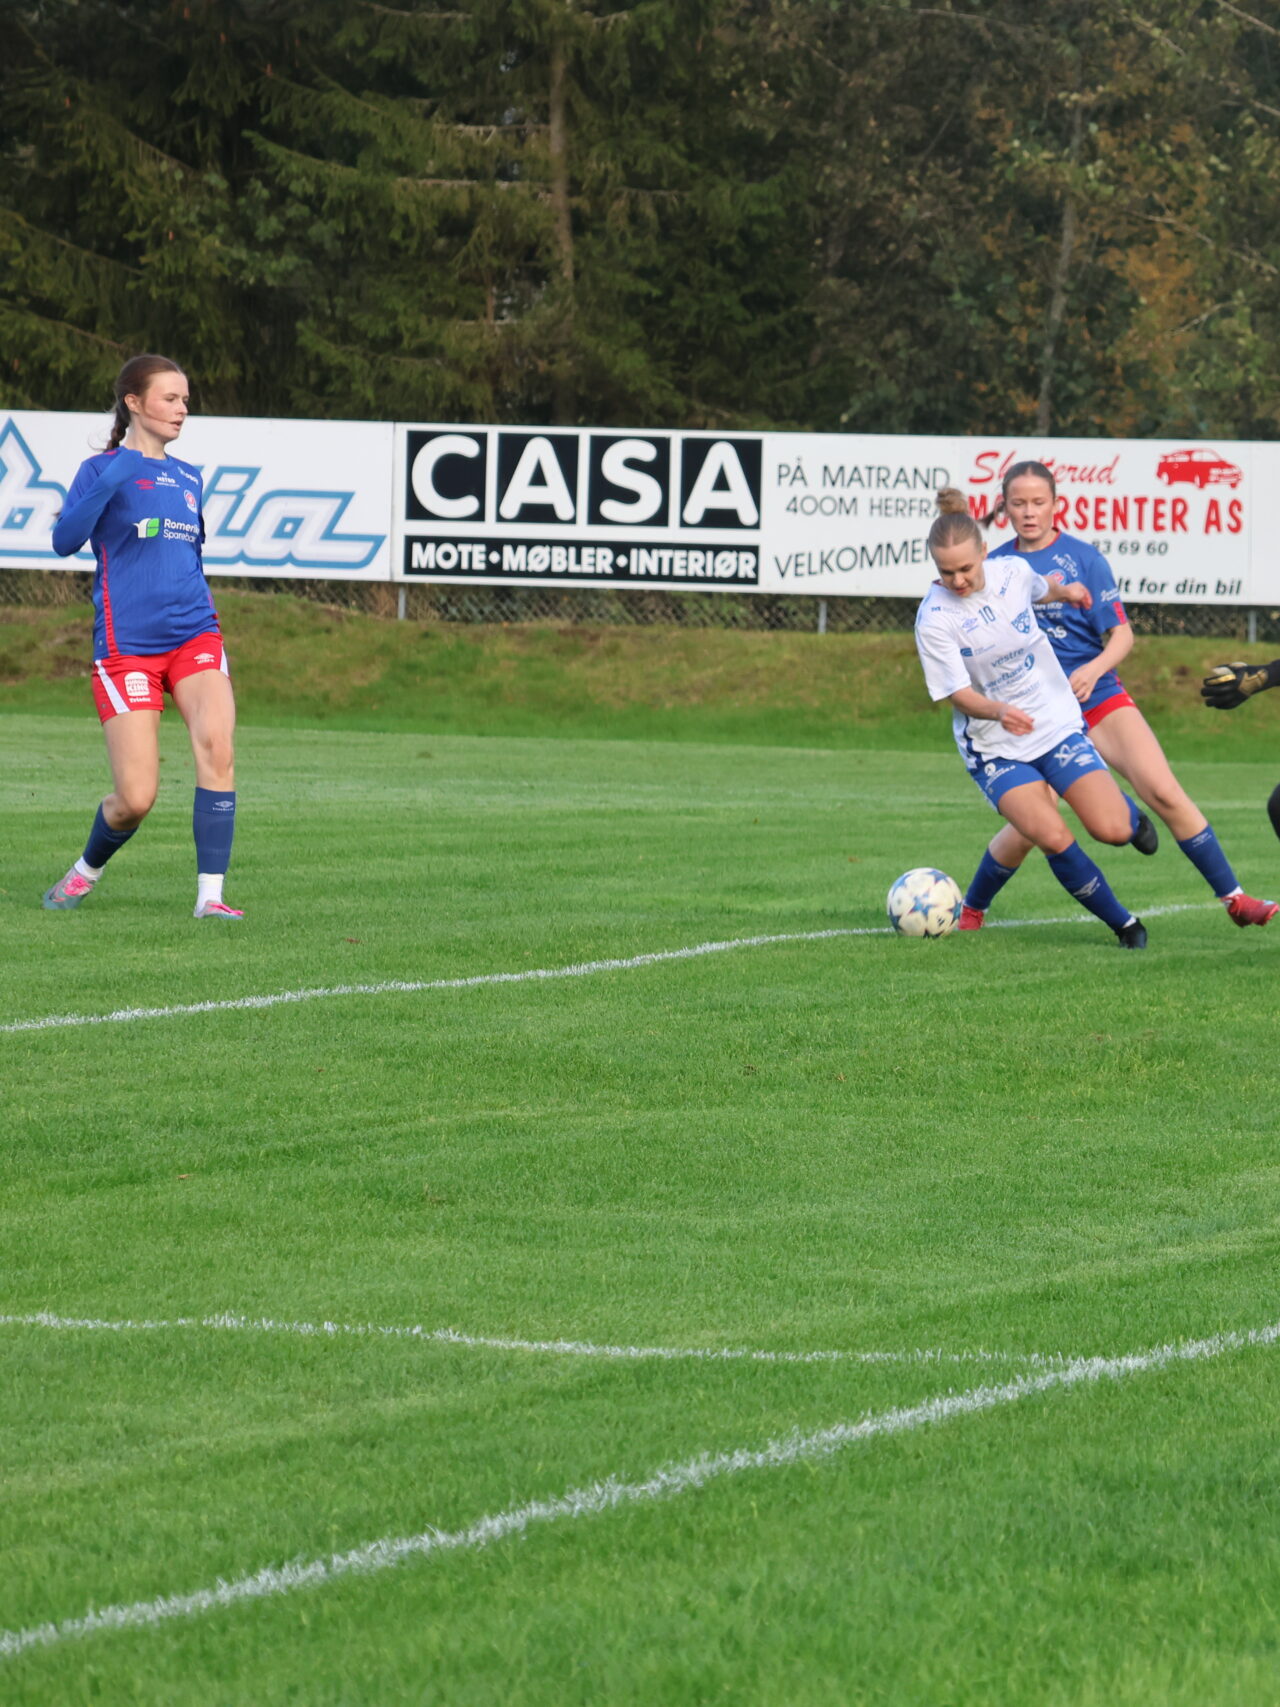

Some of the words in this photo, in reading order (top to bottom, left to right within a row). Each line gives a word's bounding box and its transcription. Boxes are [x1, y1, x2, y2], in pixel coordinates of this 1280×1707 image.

[411, 434, 759, 527] CASA
[777, 456, 808, 487] PÅ
[822, 464, 950, 490] MATRAND
[969, 450, 1120, 485] Serud
[786, 495, 859, 517] 400M
[969, 494, 1189, 533] MORSENTER
[1204, 498, 1243, 535] AS
[163, 518, 200, 535] Romerik
[411, 542, 487, 571] MOTE
[502, 544, 614, 575] MØBLER
[629, 548, 757, 579] INTERIØR
[1118, 541, 1140, 556] 69
[1147, 542, 1169, 557] 60
[1118, 578, 1131, 594] lt
[1138, 577, 1168, 595] for
[1175, 578, 1207, 595] din
[1215, 578, 1242, 596] bil
[978, 605, 996, 625] 10
